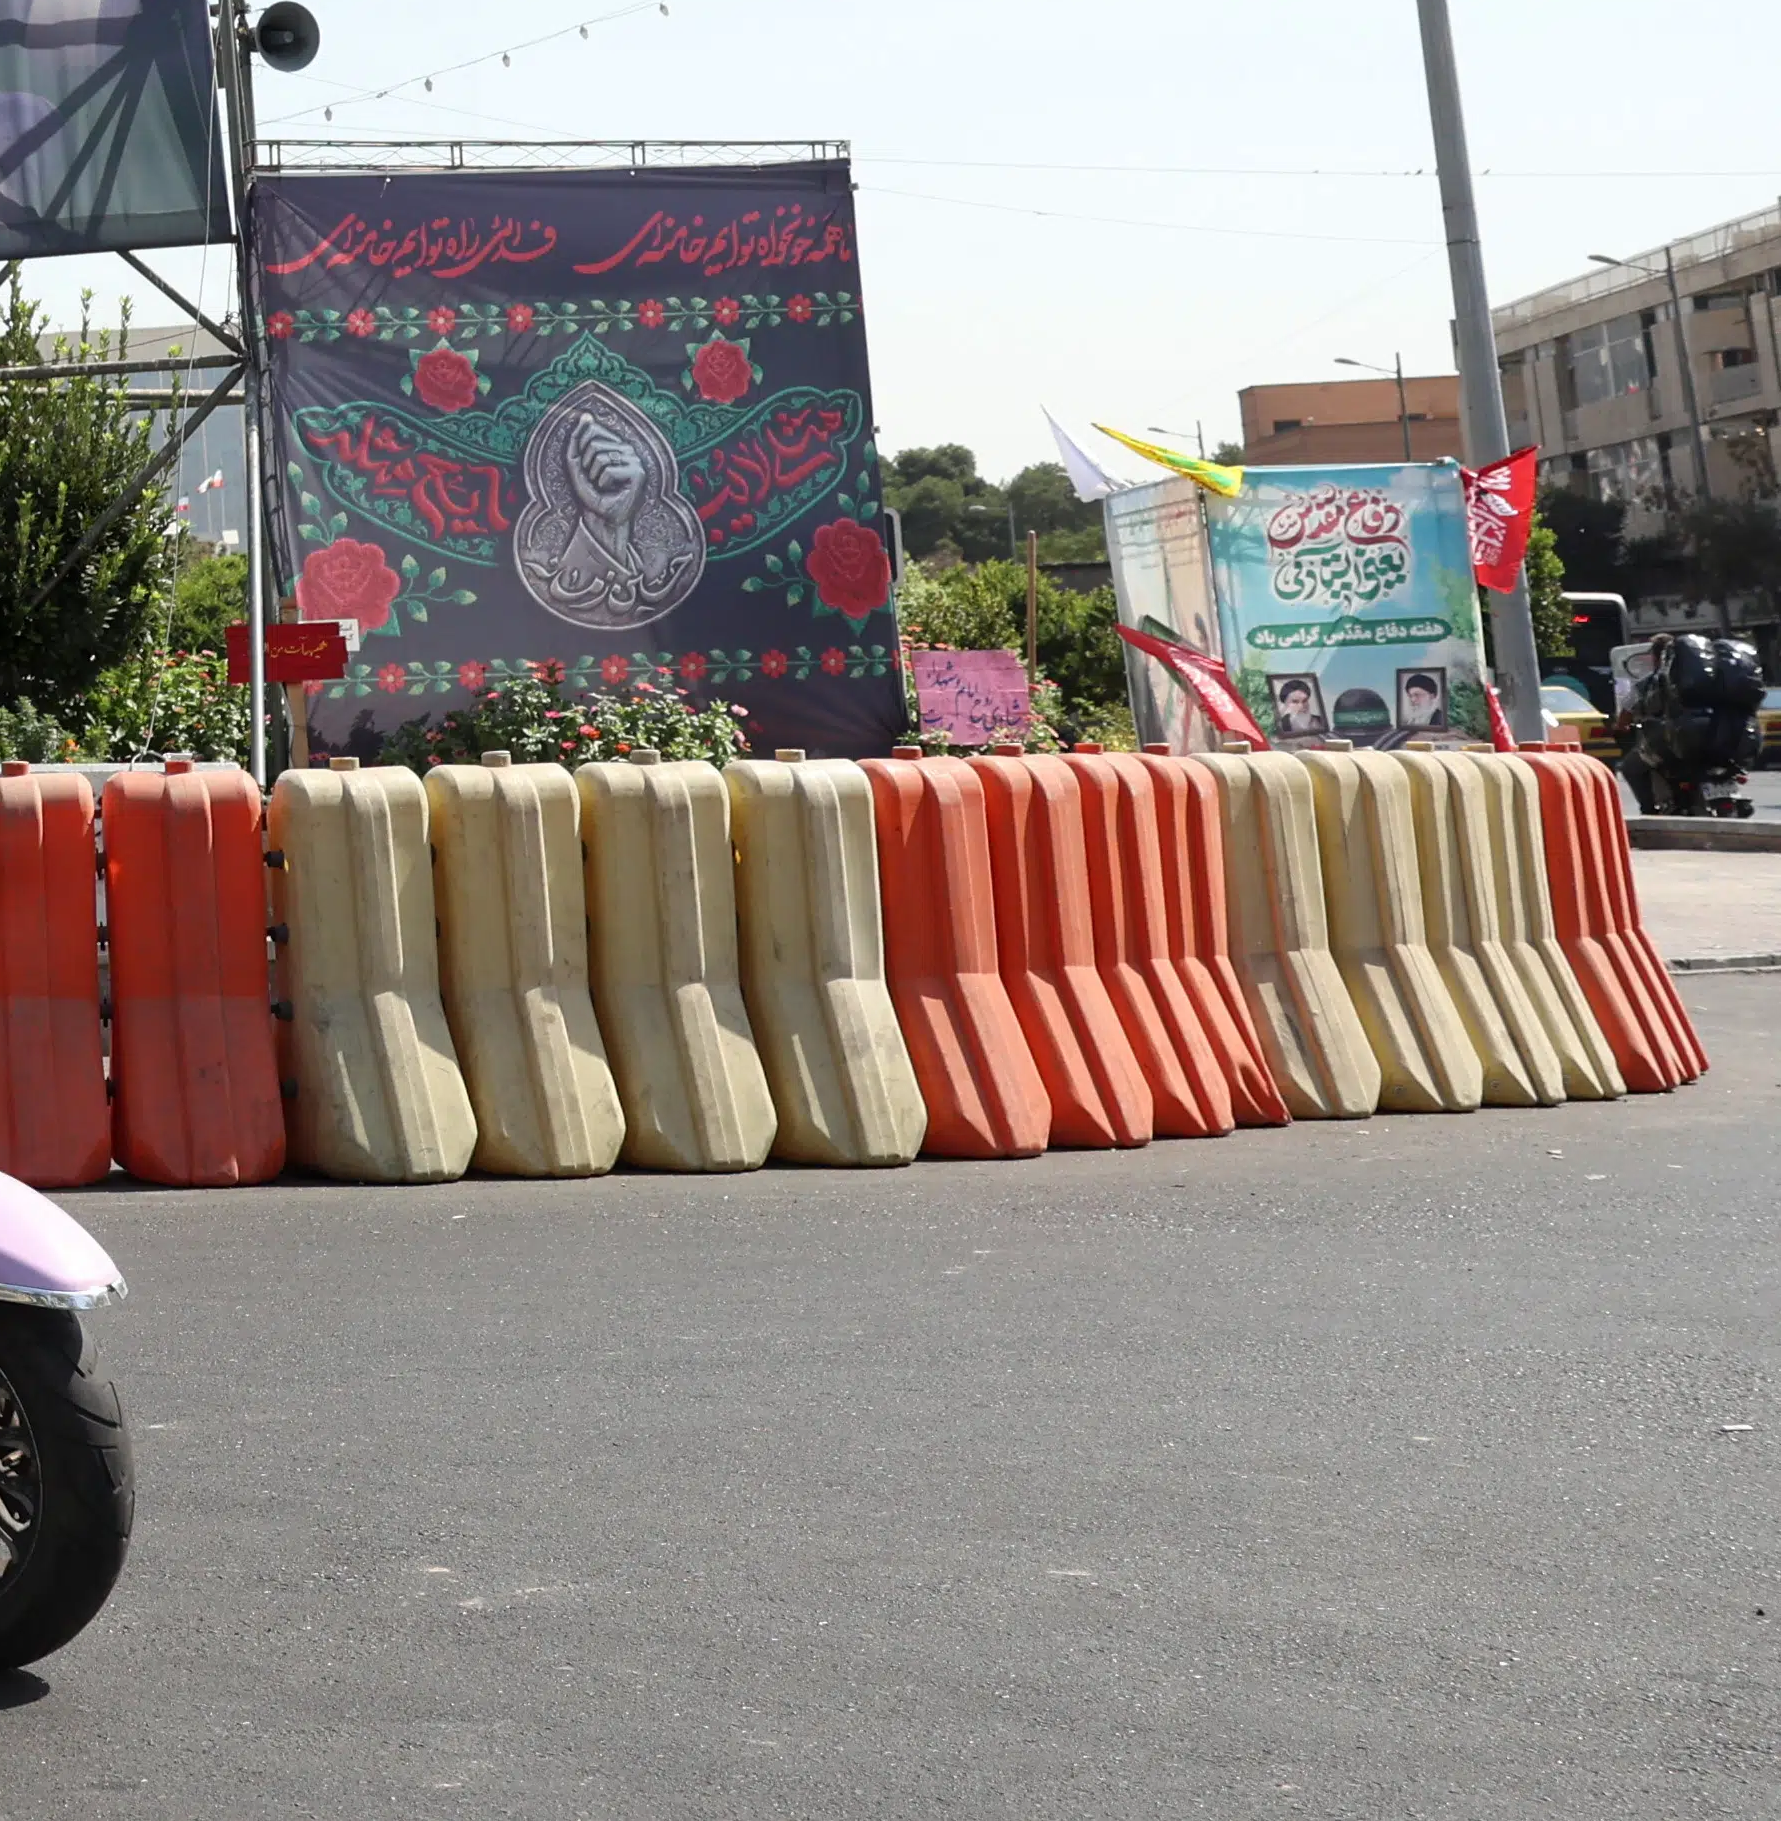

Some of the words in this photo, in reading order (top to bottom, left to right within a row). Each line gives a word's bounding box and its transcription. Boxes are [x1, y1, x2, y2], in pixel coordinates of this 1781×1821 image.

[1254, 630, 1276, 647] باد
[1277, 627, 1320, 648] گرامی
[1374, 623, 1407, 643] دفاع
[1409, 622, 1445, 637] هفته
